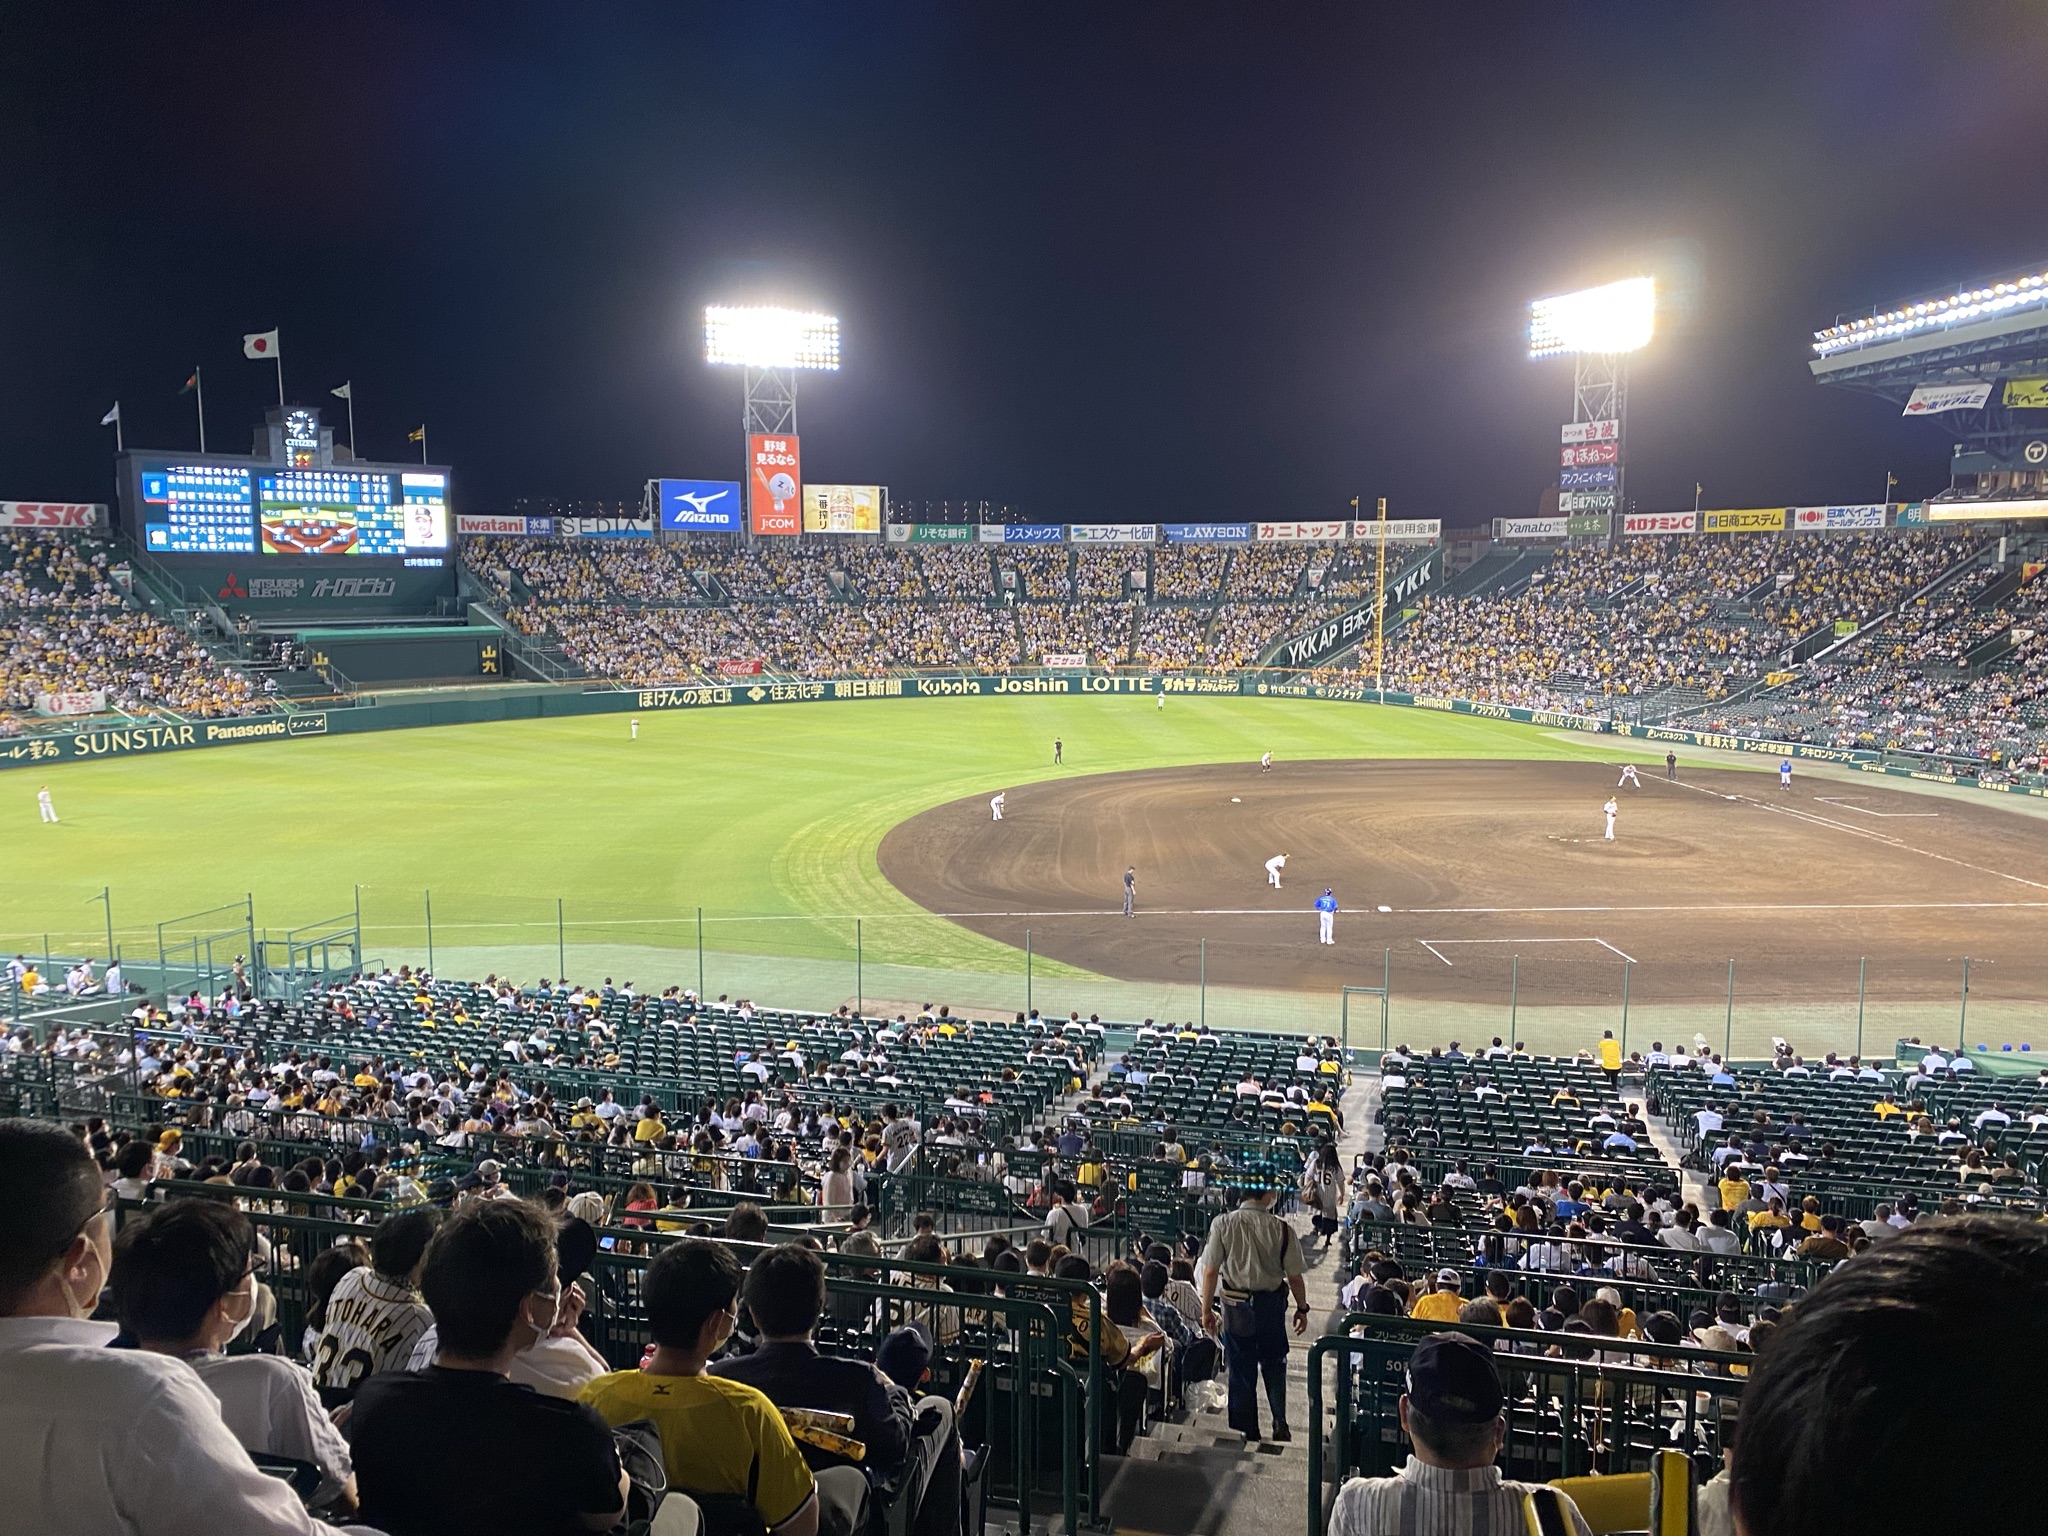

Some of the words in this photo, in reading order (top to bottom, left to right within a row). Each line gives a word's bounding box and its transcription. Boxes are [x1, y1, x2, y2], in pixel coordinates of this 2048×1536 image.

[285, 438, 317, 447] CITIZEN
[764, 440, 787, 452] 野球
[756, 454, 796, 465] 見るなら
[1576, 446, 1615, 463] ほねっこ
[13, 504, 89, 526] SSK
[818, 494, 828, 530] 一番搾り
[1827, 507, 1882, 518] 日本ペイント
[460, 517, 523, 532] Iwatani
[529, 518, 549, 530] 水素
[761, 518, 794, 530] J:COM
[1583, 518, 1601, 531] 生茶
[1626, 515, 1694, 531] オロナミンC
[1719, 513, 1781, 527] 日商エステム
[1827, 518, 1882, 527] ホールディングス
[919, 527, 967, 539] りそな銀行
[1006, 528, 1061, 539] シスメックス
[1088, 527, 1154, 540] エスケー化研
[1184, 527, 1247, 538] LAWSON
[1261, 524, 1343, 537] カニトップ
[1507, 521, 1552, 534] Yamato
[249, 579, 305, 589] MITSUBISHI
[1394, 561, 1432, 603] YKK
[249, 589, 298, 598] ELECTRIC
[481, 645, 497, 673] 山九
[1044, 657, 1084, 666] 不二サッシ
[834, 680, 901, 698] 朝日新聞
[917, 679, 980, 695] Kubota
[993, 677, 1069, 693] Joshin
[1082, 677, 1153, 692] LOTTE
[1161, 677, 1196, 691] タカラ
[1270, 684, 1308, 696] 竹中工務店
[639, 688, 726, 708] ほけんの窓口
[769, 683, 825, 701] 住友化学
[1327, 688, 1363, 700] リンテック
[1413, 695, 1453, 710] SHIMANO
[207, 720, 286, 740] Panasonic
[1654, 730, 1689, 742] レイズネクスト
[74, 725, 196, 756] SUNSTAR
[1704, 734, 1738, 750] 東海大学
[1800, 747, 1855, 763] タキロンシーアイ
